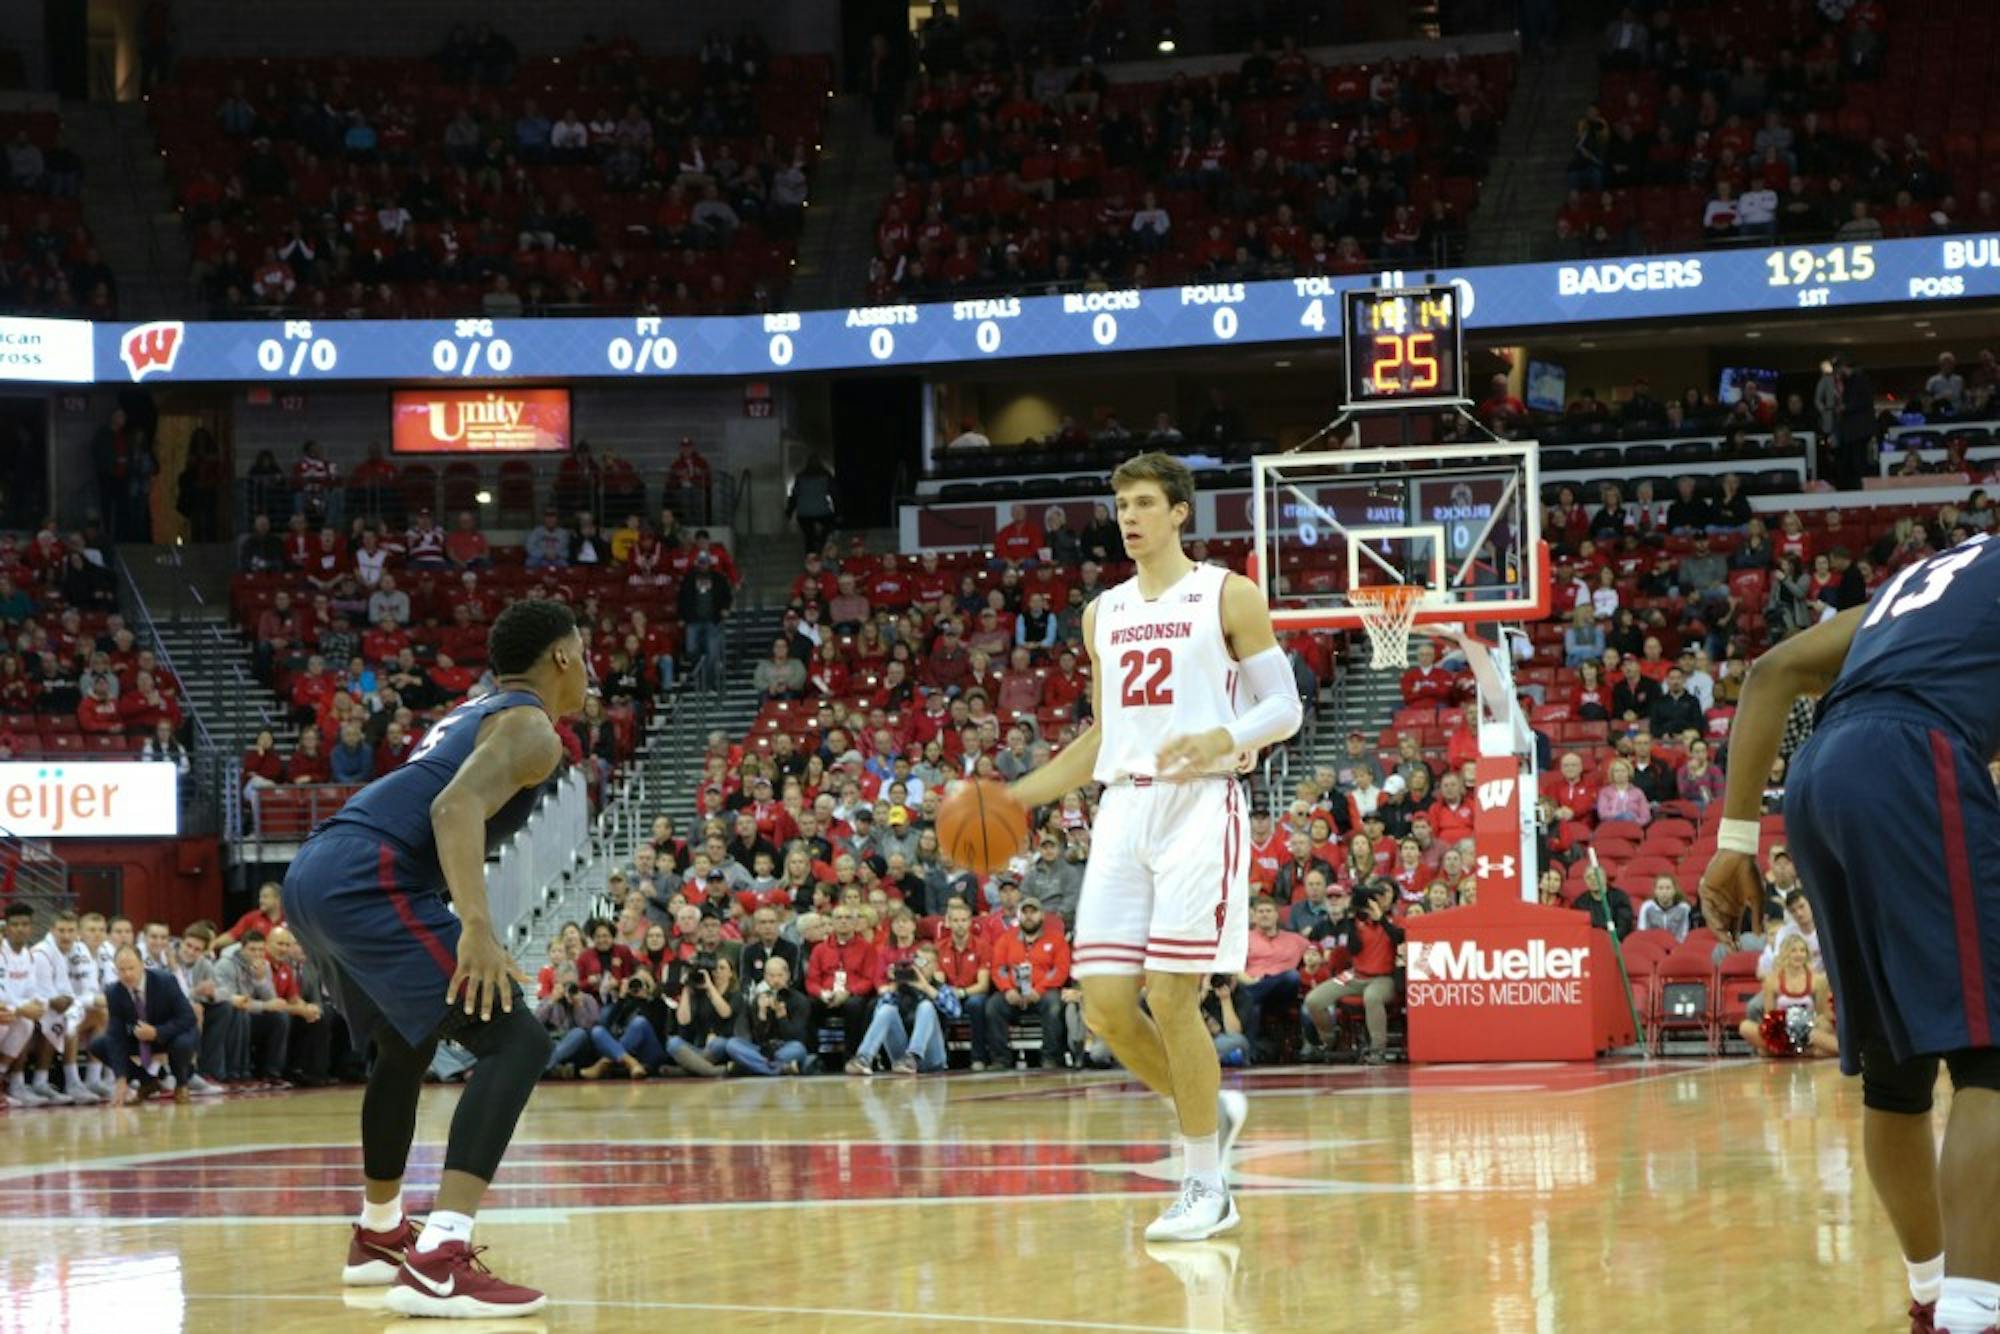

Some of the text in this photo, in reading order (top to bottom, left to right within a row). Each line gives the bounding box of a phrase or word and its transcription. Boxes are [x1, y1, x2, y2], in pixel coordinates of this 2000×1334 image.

[1559, 259, 1703, 295] BADGERS
[1766, 245, 1875, 286] 19:15
[1063, 289, 1140, 313] BLOCKS
[1181, 283, 1245, 305] FOULS
[1293, 277, 1335, 297] TOL
[1798, 287, 1830, 307] 1ST
[1909, 275, 1965, 298] POSS
[763, 313, 800, 333] REB
[846, 305, 918, 327] ASSISTS
[953, 298, 1020, 320] STEALS
[1213, 307, 1238, 339] 0
[1301, 299, 1326, 332] 4
[284, 320, 313, 339] FG
[455, 319, 494, 337] 3FG
[636, 317, 661, 336] FT
[976, 320, 1001, 353] 0
[1092, 313, 1117, 346] 0
[769, 334, 793, 366] 0
[869, 327, 894, 360] 0
[1374, 333, 1438, 389] 25
[427, 393, 524, 442] Unity
[749, 401, 770, 417] 127
[1862, 543, 1985, 630] 13
[1110, 621, 1193, 646] WISCONSIN
[1120, 647, 1174, 708] 22
[6, 767, 119, 831] eijer
[1477, 778, 1516, 813] W
[1433, 939, 1590, 981] Mueller
[1408, 981, 1583, 1008] SPORTS MEDICINE
